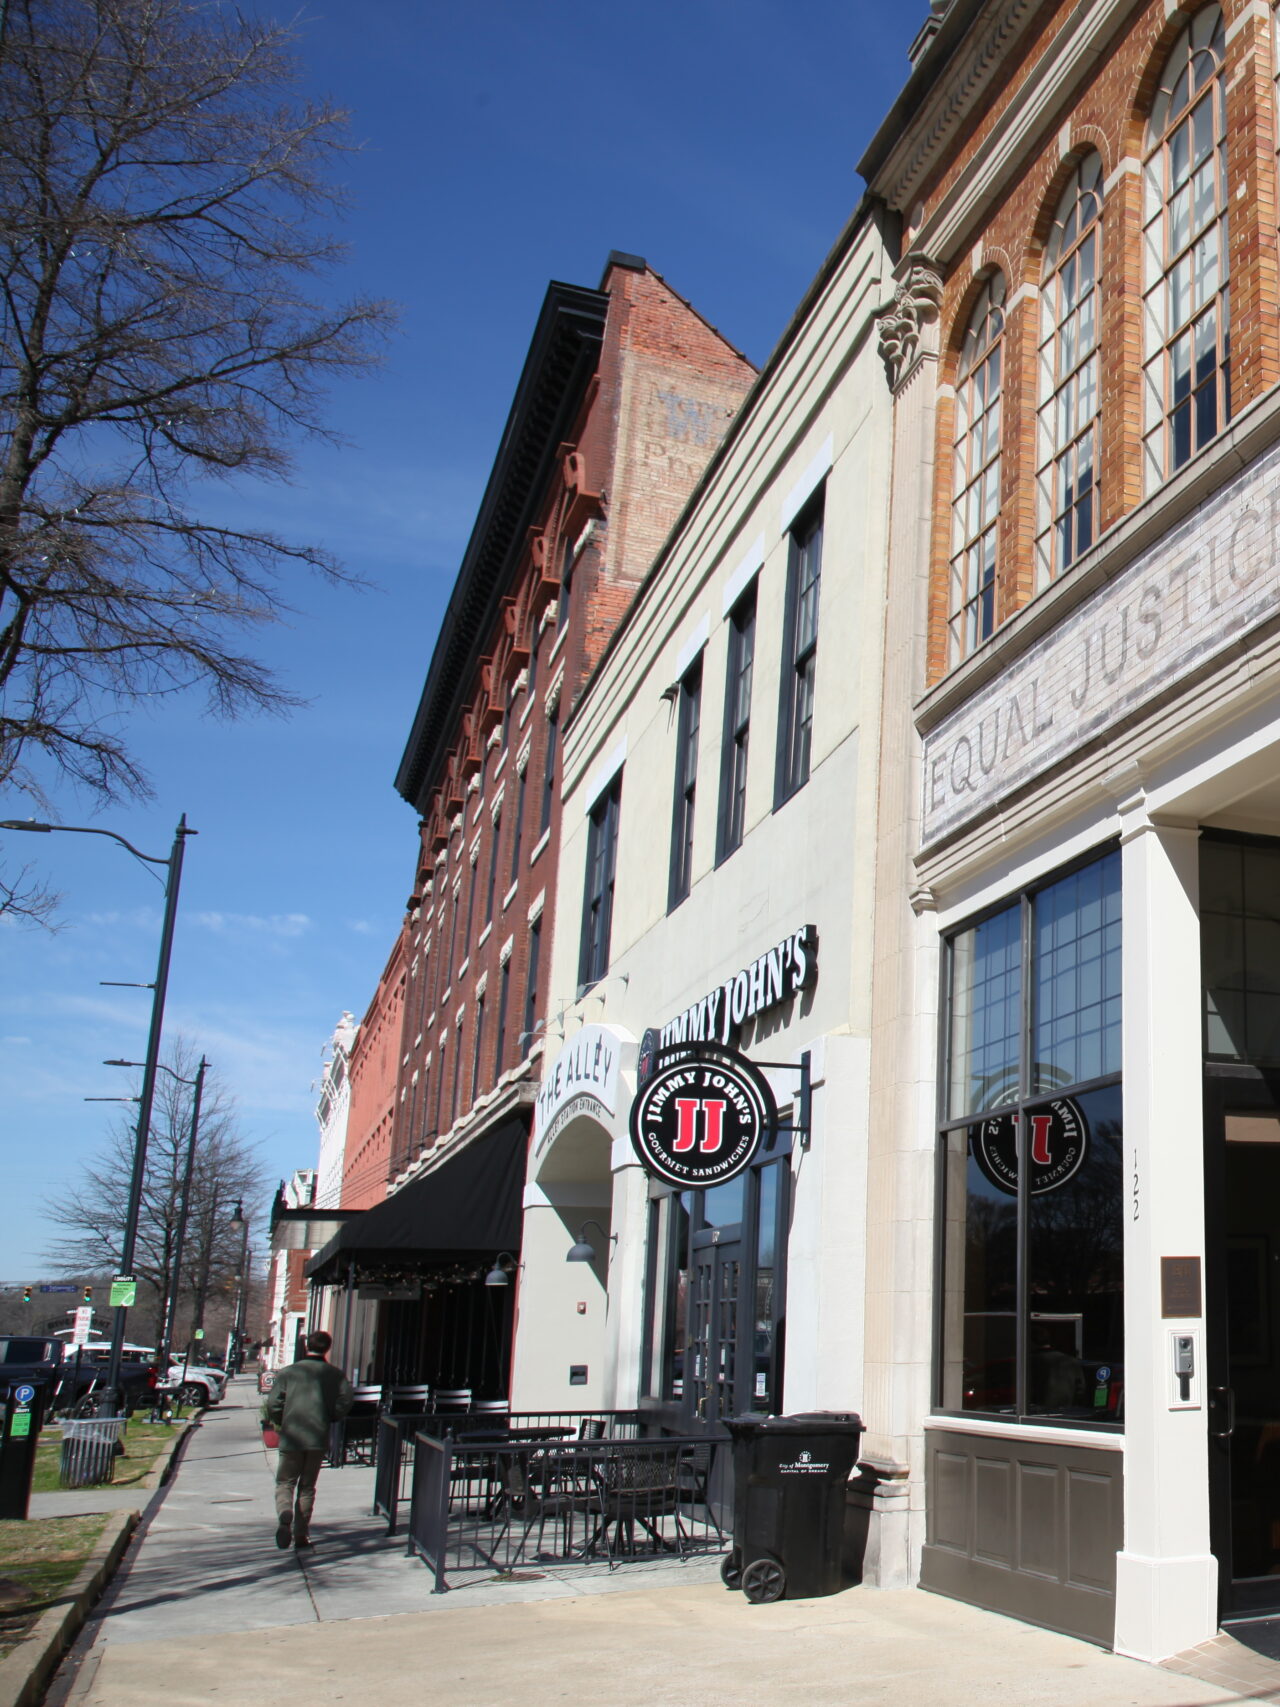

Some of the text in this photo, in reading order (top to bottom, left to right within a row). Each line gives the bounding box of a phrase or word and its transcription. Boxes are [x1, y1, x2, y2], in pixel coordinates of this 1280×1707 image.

[928, 677, 1054, 813] EQUAL
[659, 926, 807, 1069] JIMMY JOHN'S
[537, 1062, 562, 1126] THE
[566, 1038, 612, 1088] ALLEY
[579, 1098, 602, 1118] ENTRANCE
[647, 1071, 752, 1125] JIMMY JOHN'S
[673, 1098, 726, 1153] JJ
[648, 1132, 750, 1177] GOURMET SANDWICHES
[1132, 1147, 1140, 1222] 122
[795, 1461, 829, 1469] Montgomery
